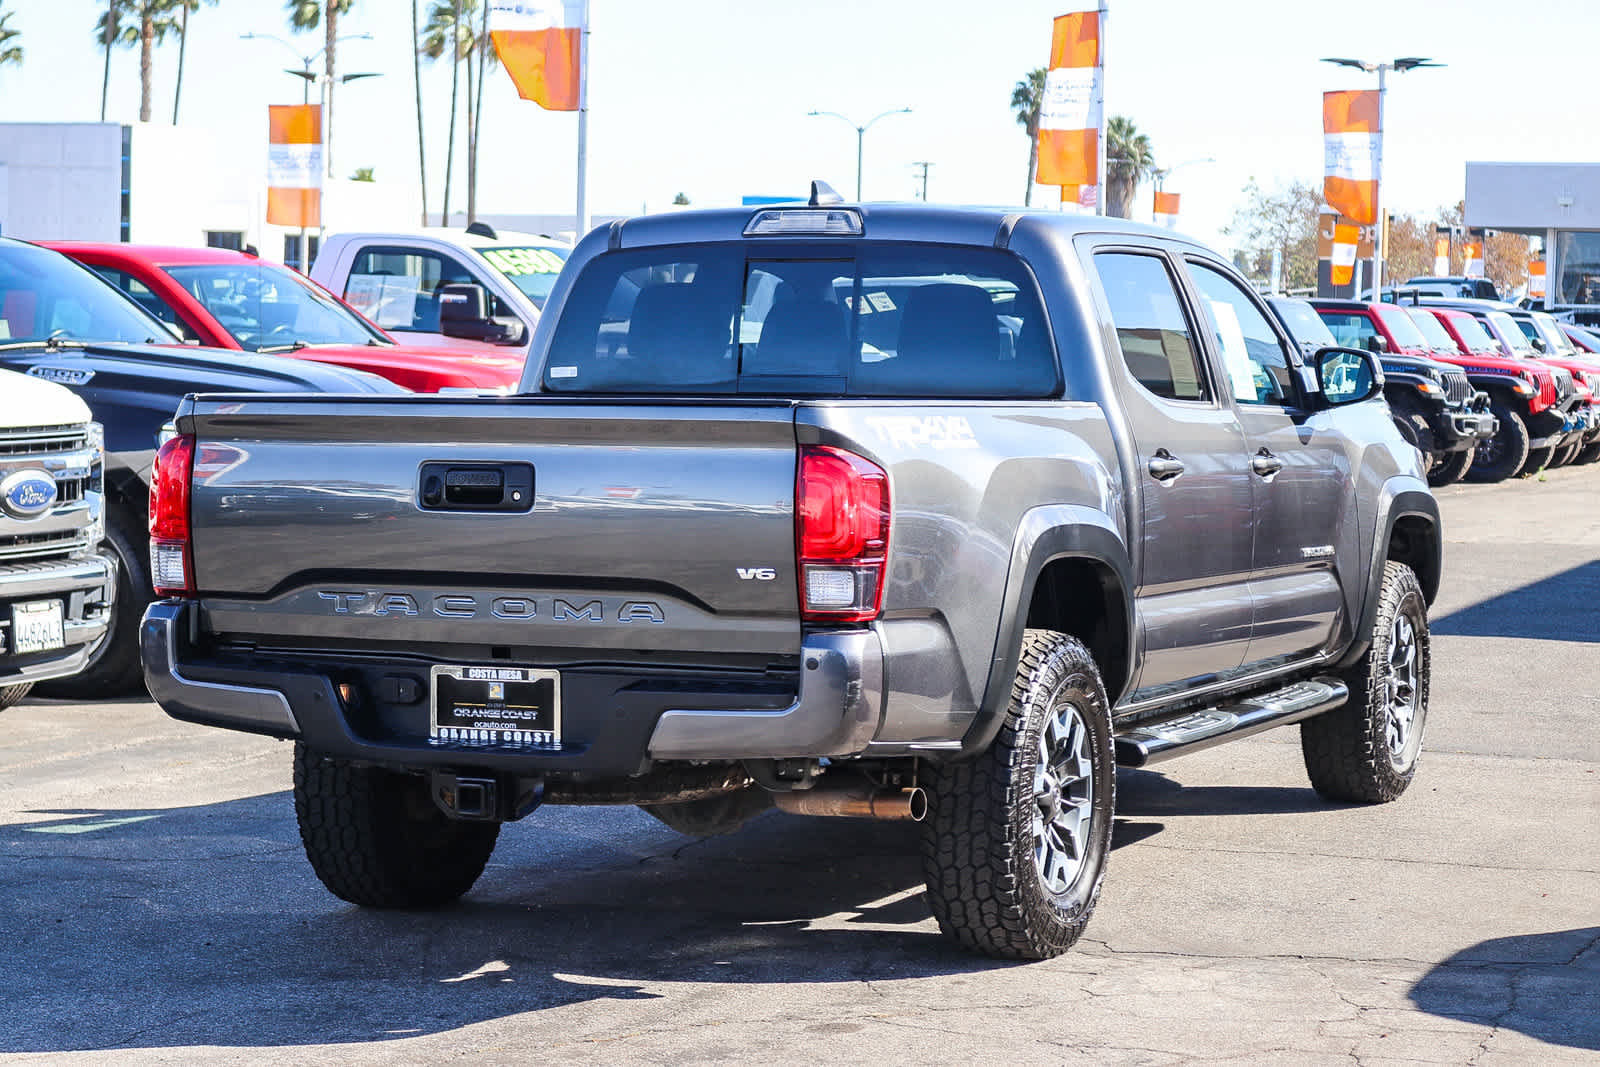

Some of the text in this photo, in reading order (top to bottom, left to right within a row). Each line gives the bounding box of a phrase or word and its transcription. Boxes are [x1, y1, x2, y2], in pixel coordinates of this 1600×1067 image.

[1322, 220, 1375, 243] Jep
[20, 484, 48, 505] Ford
[736, 568, 776, 580] V6
[318, 592, 665, 623] TACOMA
[468, 668, 522, 680] COSTA MESA
[453, 708, 539, 720] ORANGE COAST
[473, 721, 517, 730] ocauto.com
[440, 728, 552, 743] ORANGE COAST
